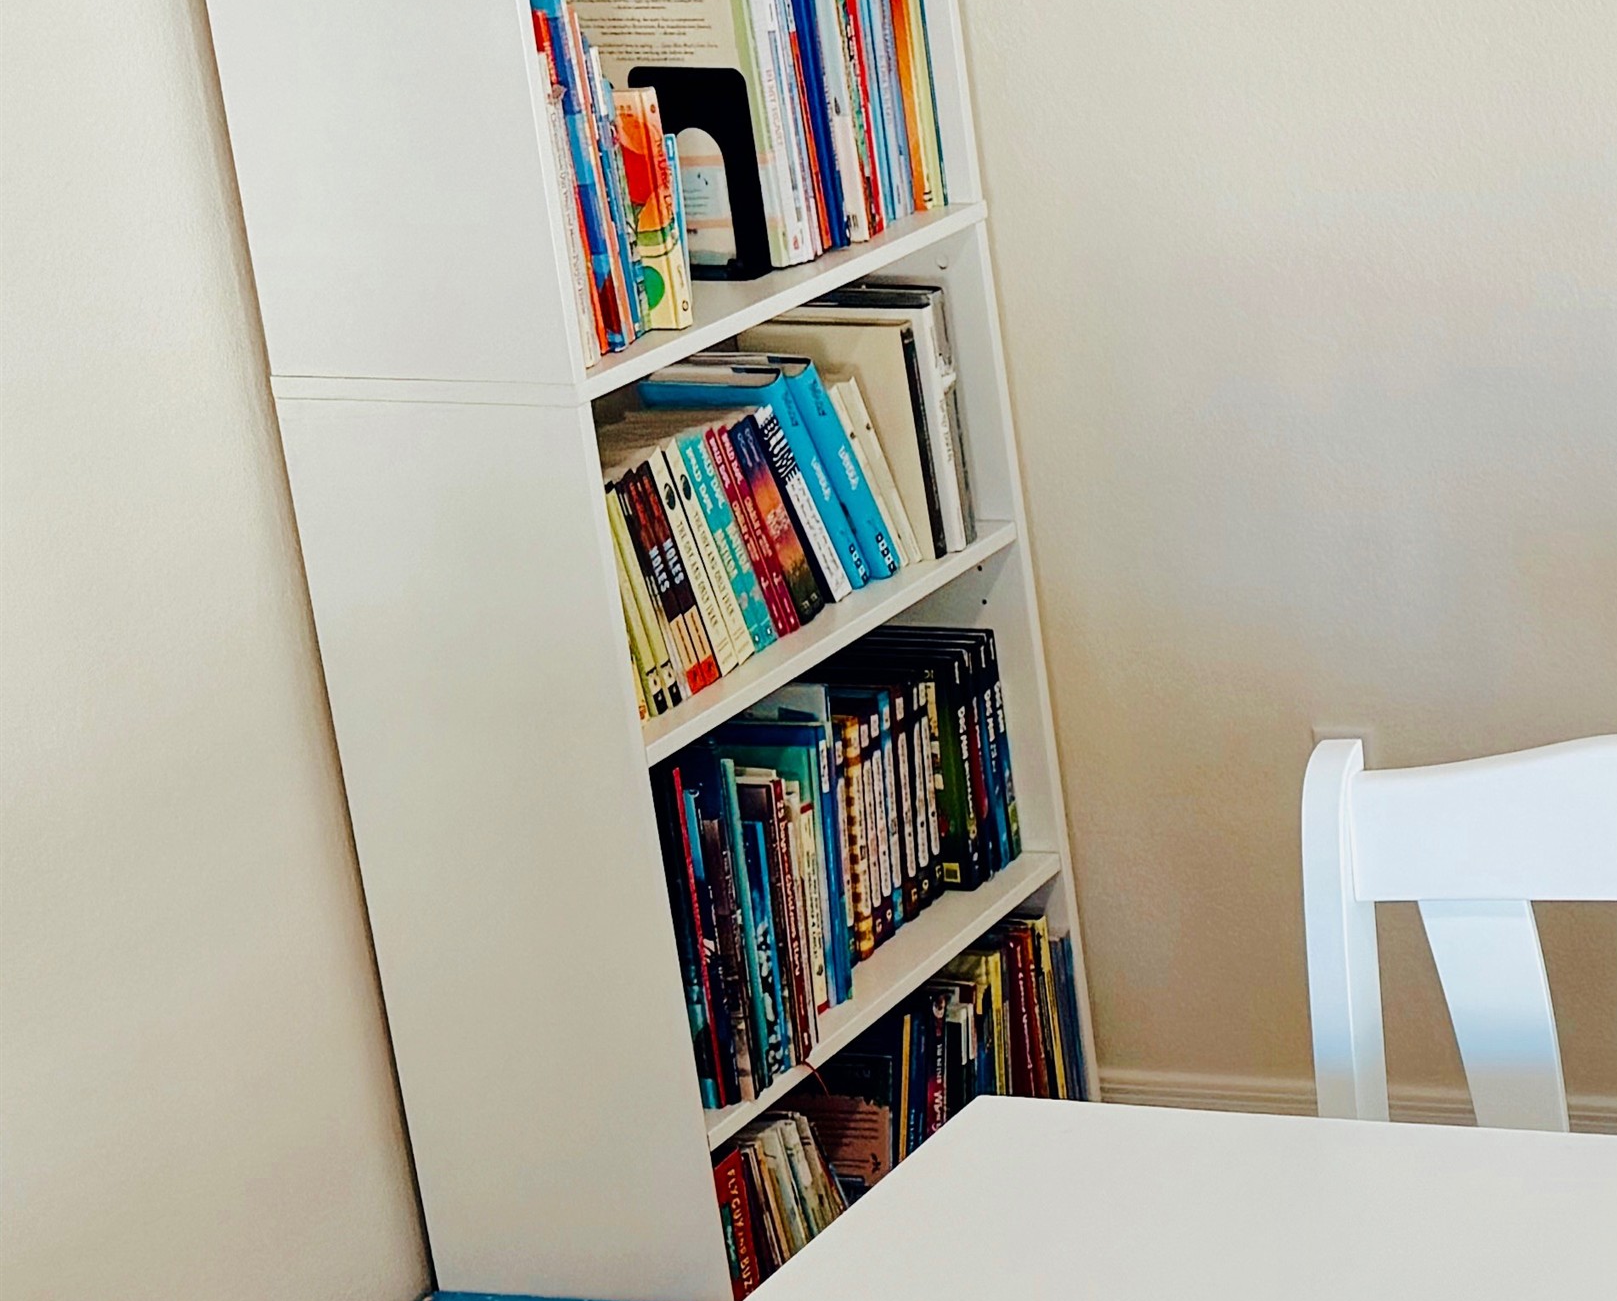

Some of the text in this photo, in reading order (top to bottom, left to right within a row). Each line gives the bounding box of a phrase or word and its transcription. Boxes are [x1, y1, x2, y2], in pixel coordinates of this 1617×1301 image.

[765, 415, 802, 480] BLUME
[649, 545, 671, 593] HOLES
[663, 540, 685, 586] HOLES
[982, 691, 993, 716] DOG
[956, 706, 969, 733] DOG
[727, 1168, 740, 1197] FLY
[731, 1198, 744, 1228] GUY
